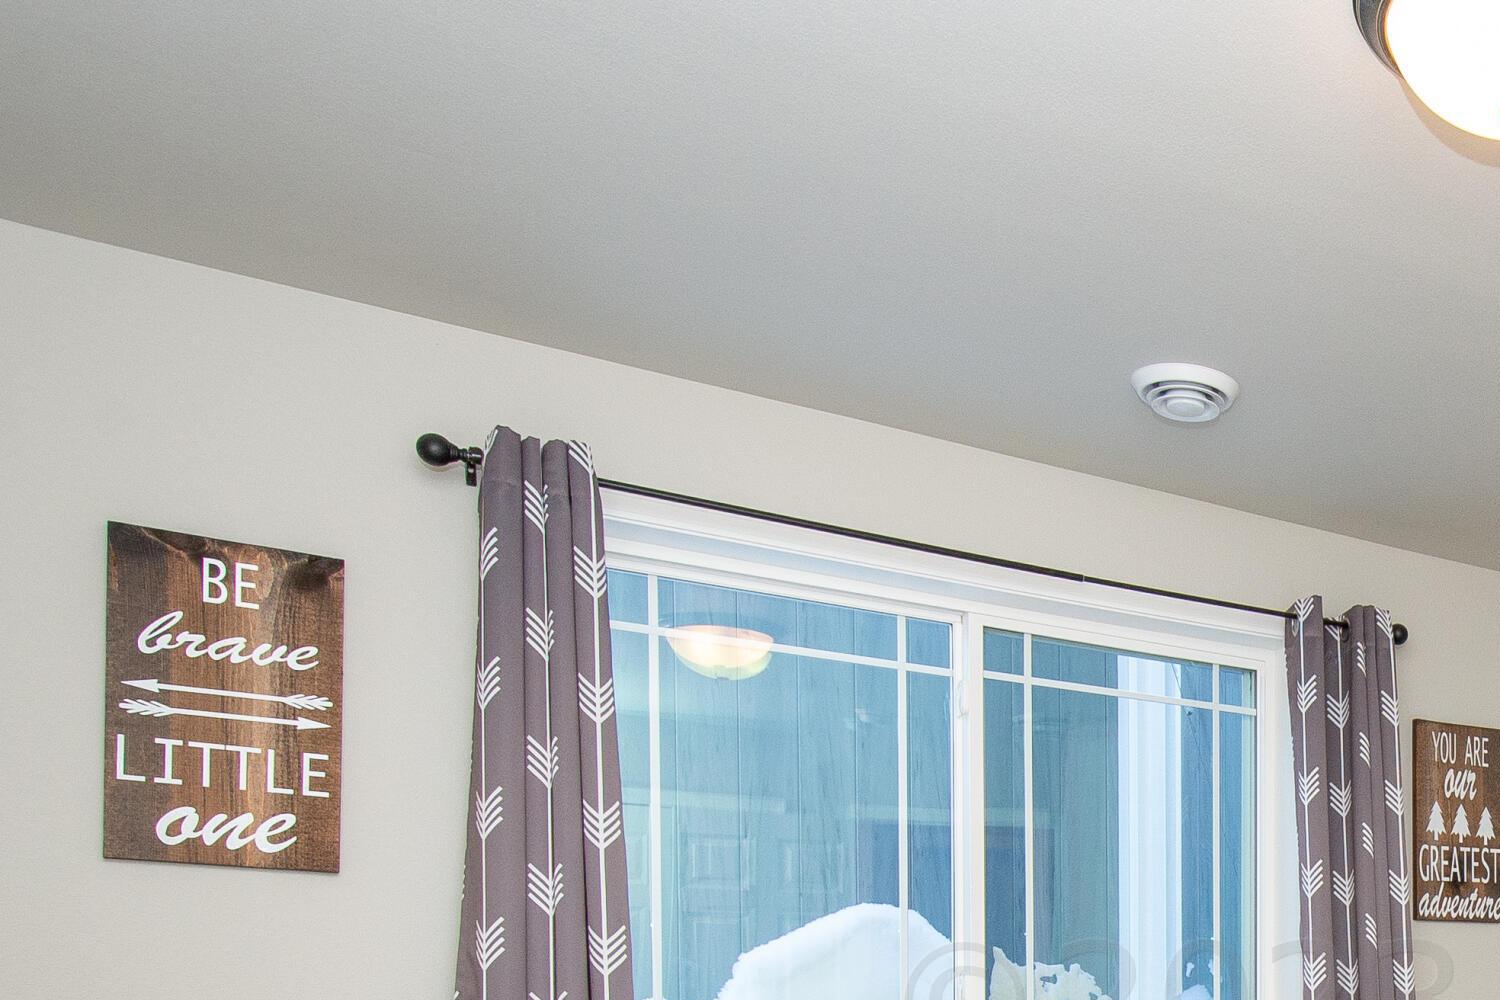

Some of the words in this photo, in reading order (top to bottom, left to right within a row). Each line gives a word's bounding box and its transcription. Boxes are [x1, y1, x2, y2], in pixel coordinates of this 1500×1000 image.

[202, 557, 261, 610] BE
[137, 610, 320, 671] brave
[115, 733, 330, 799] LITTLE
[1431, 731, 1457, 765] YOU
[1464, 735, 1490, 768] ARE
[1443, 767, 1478, 801] our
[155, 806, 298, 854] one
[1419, 843, 1500, 885] GREATEST
